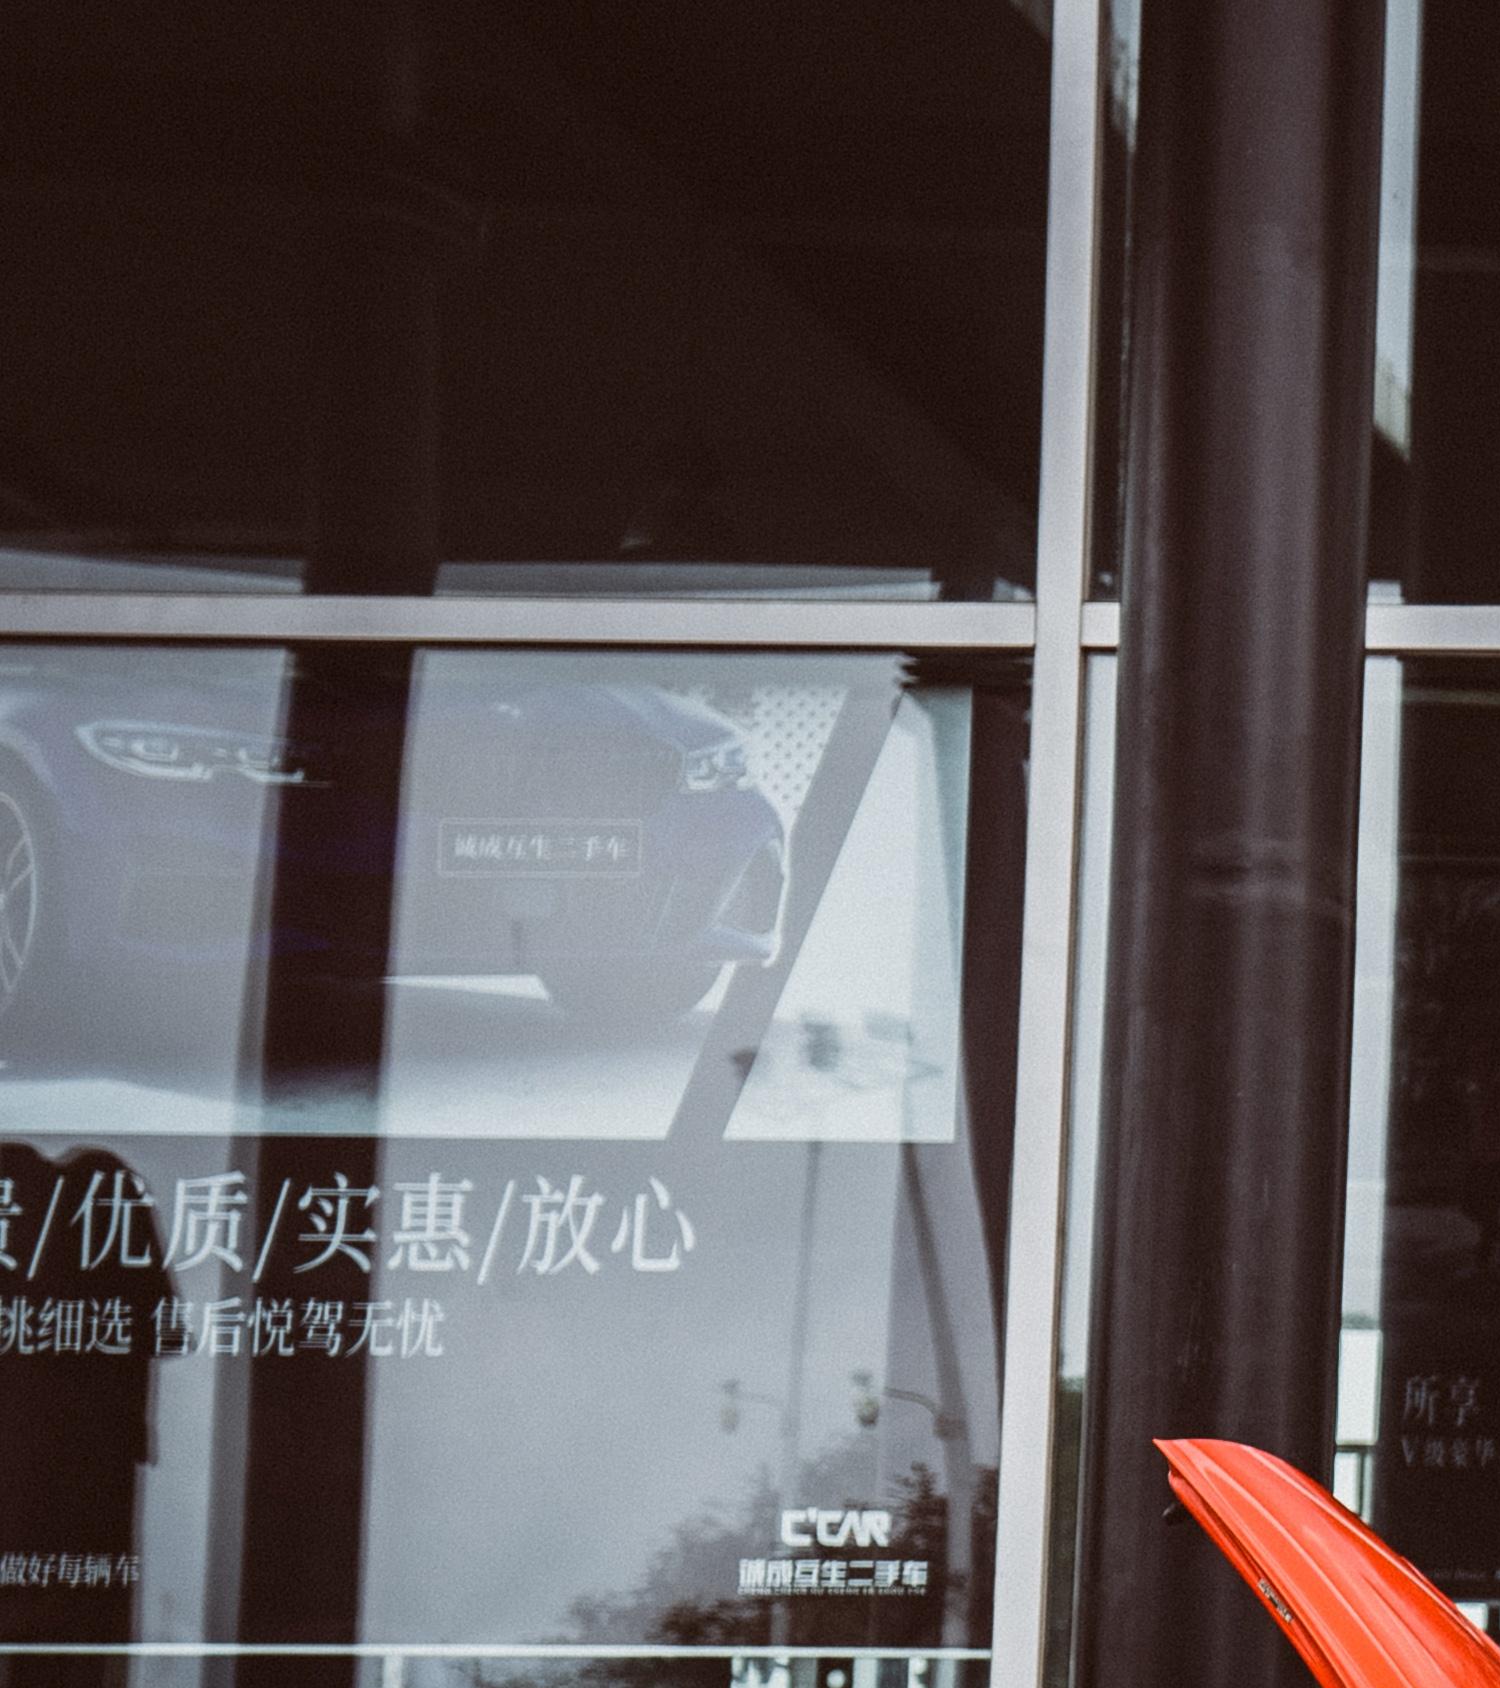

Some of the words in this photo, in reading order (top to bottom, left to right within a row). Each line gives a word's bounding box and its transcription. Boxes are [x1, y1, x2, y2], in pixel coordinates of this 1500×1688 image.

[153, 1297, 445, 1358] 售后悦驾无忧
